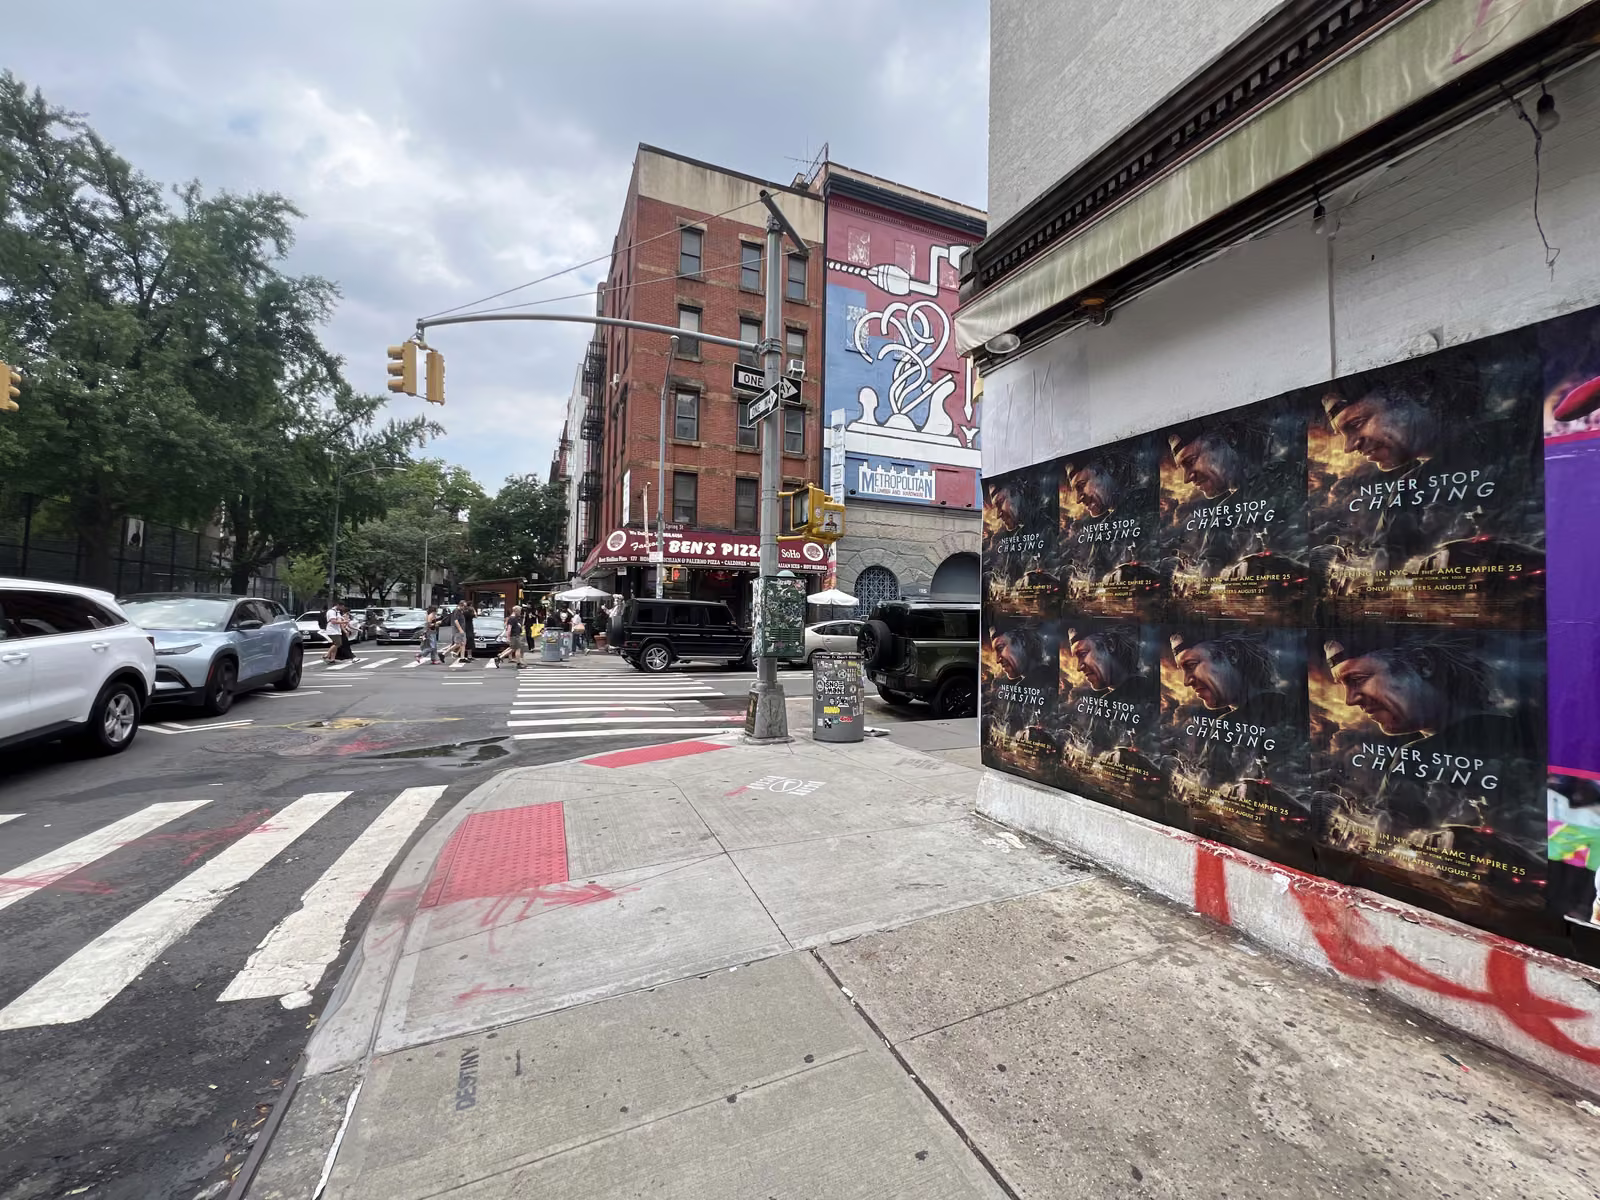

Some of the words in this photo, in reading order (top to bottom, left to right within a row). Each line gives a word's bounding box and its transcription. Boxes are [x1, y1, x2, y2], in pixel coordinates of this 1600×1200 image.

[744, 374, 764, 387] ONE
[780, 382, 791, 394] AY
[862, 471, 932, 498] METROPOLITAN
[1360, 478, 1418, 496] NEVER
[1428, 470, 1480, 487] STOP
[1350, 482, 1496, 512] CHASING
[1193, 505, 1229, 518] NEVER
[1235, 500, 1267, 513] STOP
[1083, 523, 1109, 533] NEVER
[1112, 519, 1135, 529] STOP
[1186, 509, 1275, 531] CHASING
[1001, 536, 1020, 544] NEVER
[1023, 533, 1039, 541] STOP
[1077, 527, 1141, 543] CHASING
[669, 540, 717, 555] BEN'S
[721, 542, 760, 557] PIZZ
[781, 548, 801, 559] SoHo
[997, 540, 1044, 553] CHASING
[1375, 569, 1386, 577] IN
[1438, 566, 1462, 574] AMC
[1465, 565, 1504, 573] EMPIRE
[1508, 564, 1522, 572] 25
[998, 691, 1045, 706] CHASING
[1001, 684, 1022, 693] NEVER
[1024, 687, 1040, 696] STOP
[1077, 703, 1141, 724] CHASING
[1081, 696, 1108, 708] NEVER
[1112, 701, 1135, 712] STOP
[1193, 715, 1229, 730] NEVER
[1235, 723, 1266, 736] STOP
[1186, 724, 1276, 751] CHASING
[1362, 742, 1421, 762] NEVER
[1432, 752, 1484, 771] STOP
[1352, 754, 1499, 790] CHASING
[1253, 801, 1277, 813] EMPIRE
[1367, 846, 1387, 856] ONLY
[1399, 854, 1434, 868] THEATERS
[1436, 864, 1469, 877] AUGUST
[1472, 873, 1481, 881] 21
[1379, 832, 1390, 840] IN
[1442, 848, 1466, 860] AMC
[1470, 854, 1508, 871] EMPIRE
[1512, 866, 1526, 876] 25
